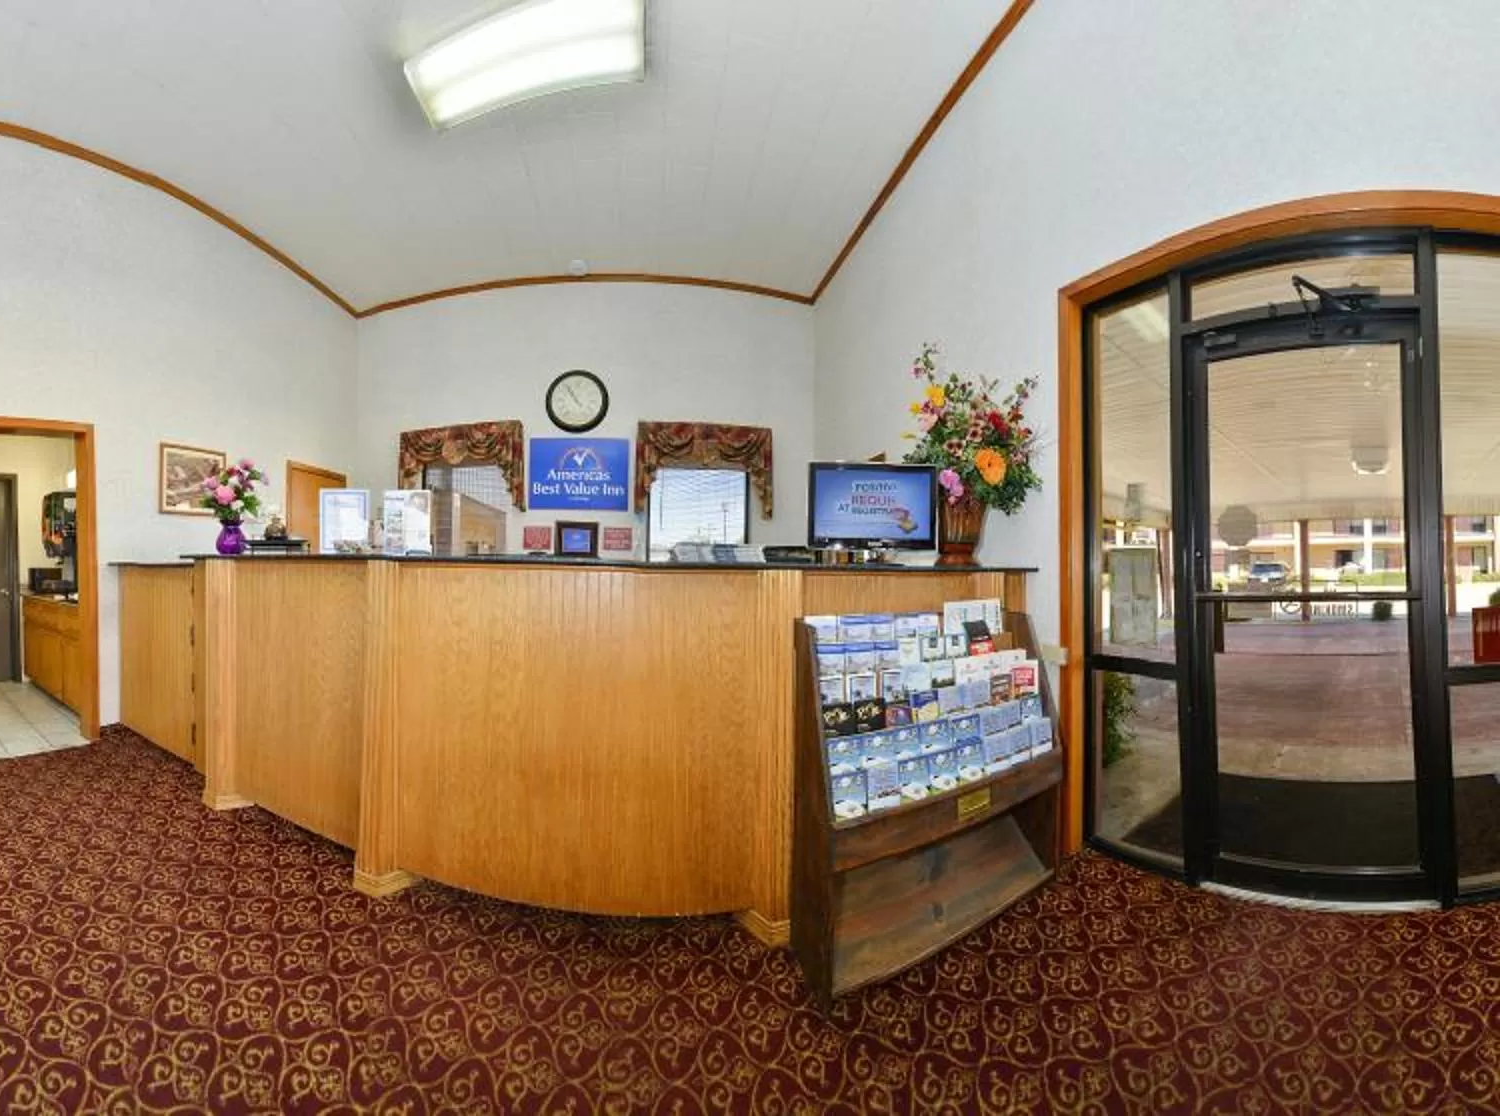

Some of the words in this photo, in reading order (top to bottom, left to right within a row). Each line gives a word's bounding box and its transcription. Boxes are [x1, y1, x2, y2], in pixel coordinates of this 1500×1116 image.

[547, 468, 612, 481] Americas
[532, 482, 560, 495] Best
[564, 481, 600, 496] Value
[603, 482, 626, 497] Inn
[836, 503, 850, 513] AT
